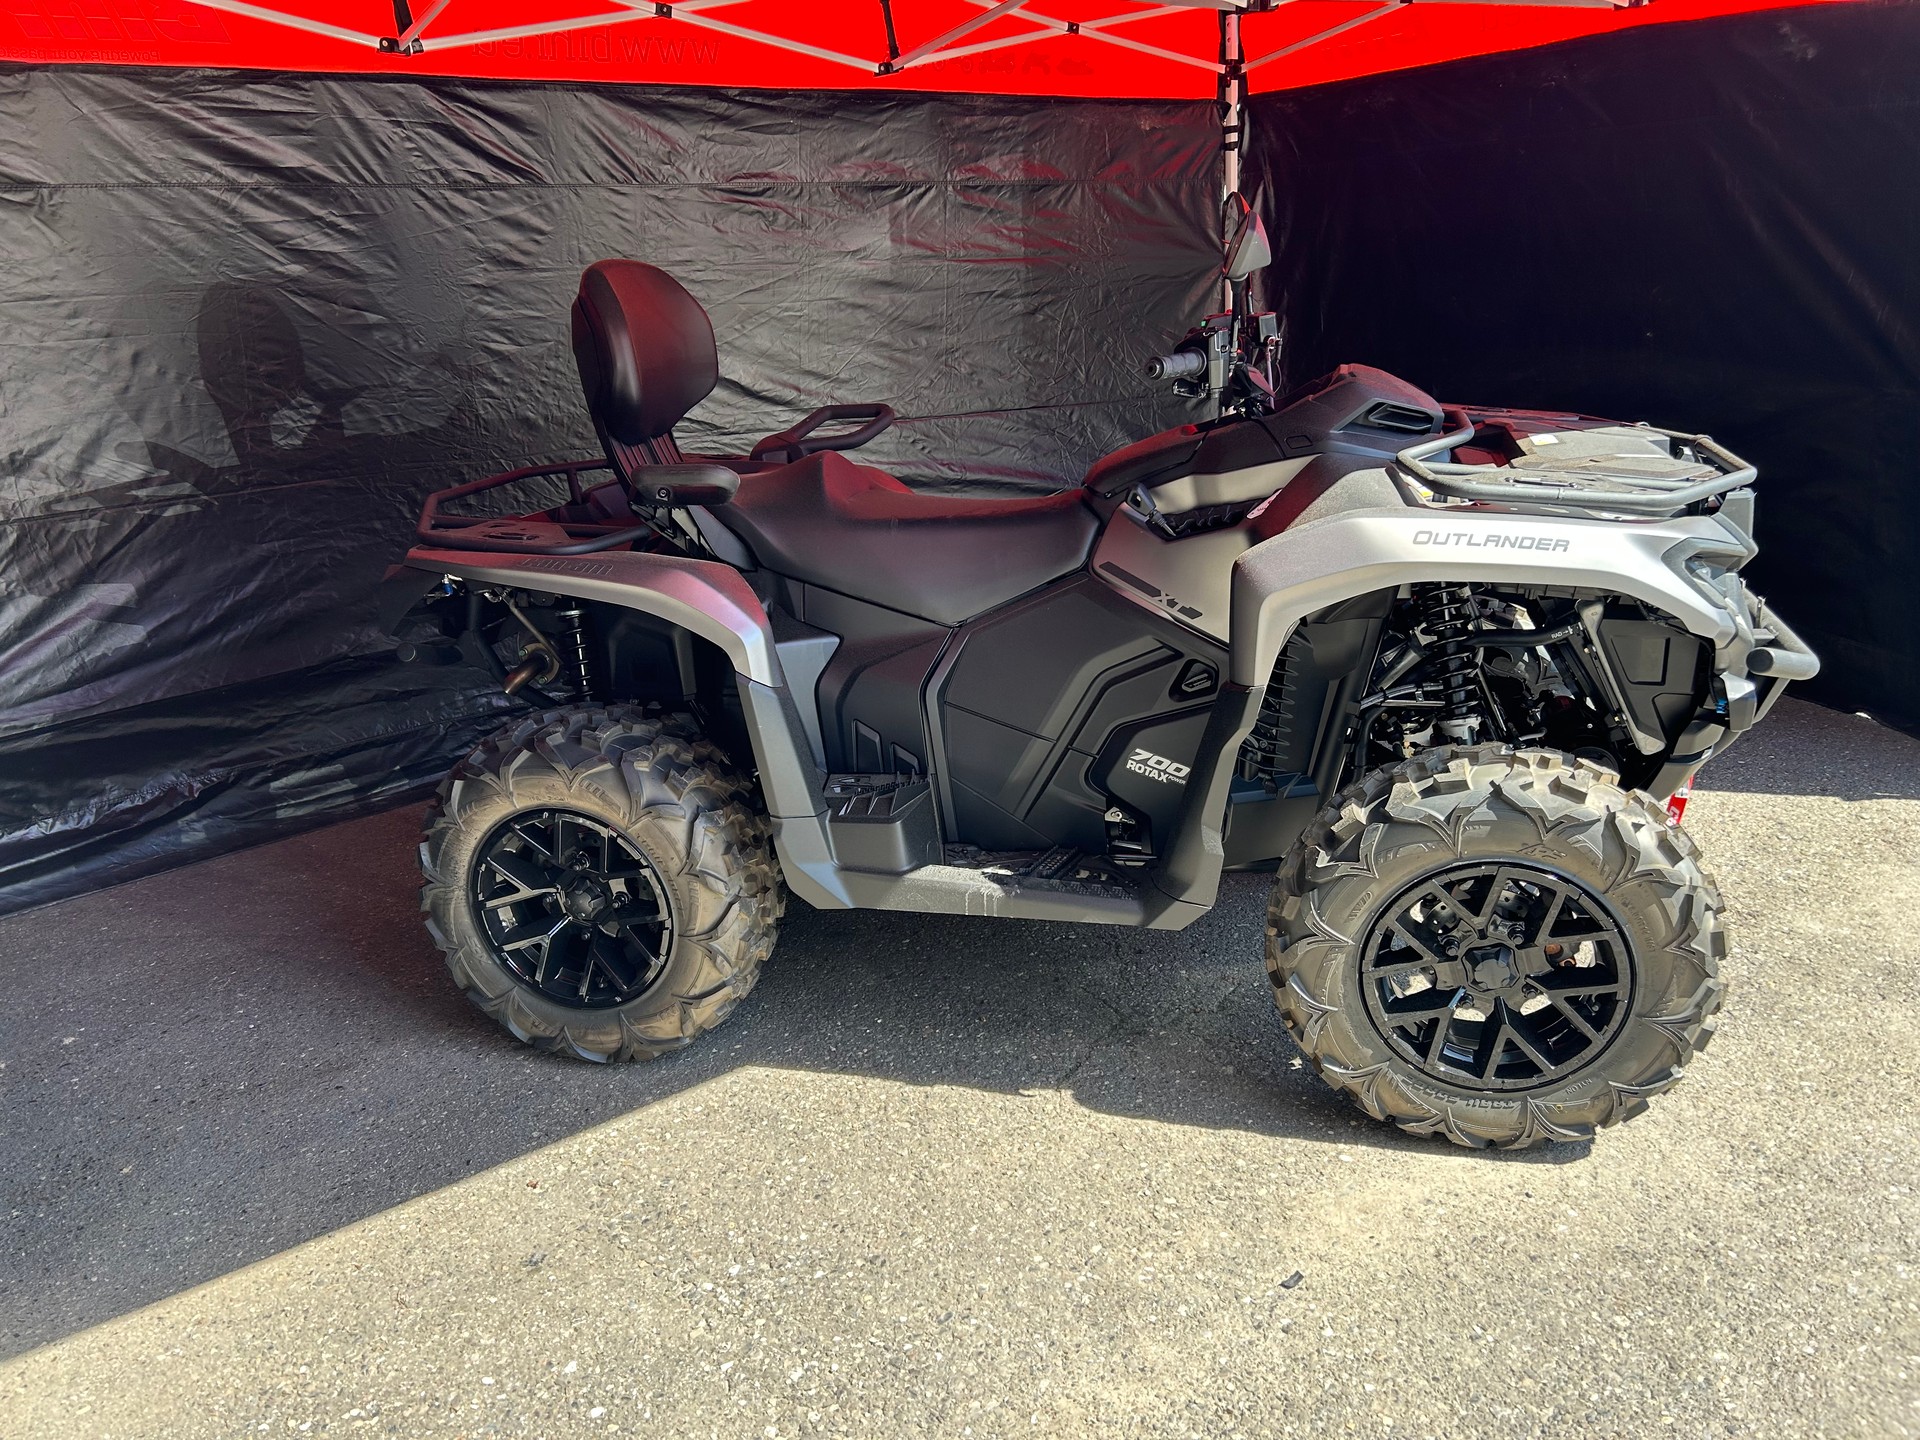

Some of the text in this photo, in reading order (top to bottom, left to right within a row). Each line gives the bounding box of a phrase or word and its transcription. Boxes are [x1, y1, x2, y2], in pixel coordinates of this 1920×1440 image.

[1412, 530, 1570, 552] OUTLANDER
[1126, 759, 1168, 783] ROTAX
[1130, 748, 1190, 777] 700
